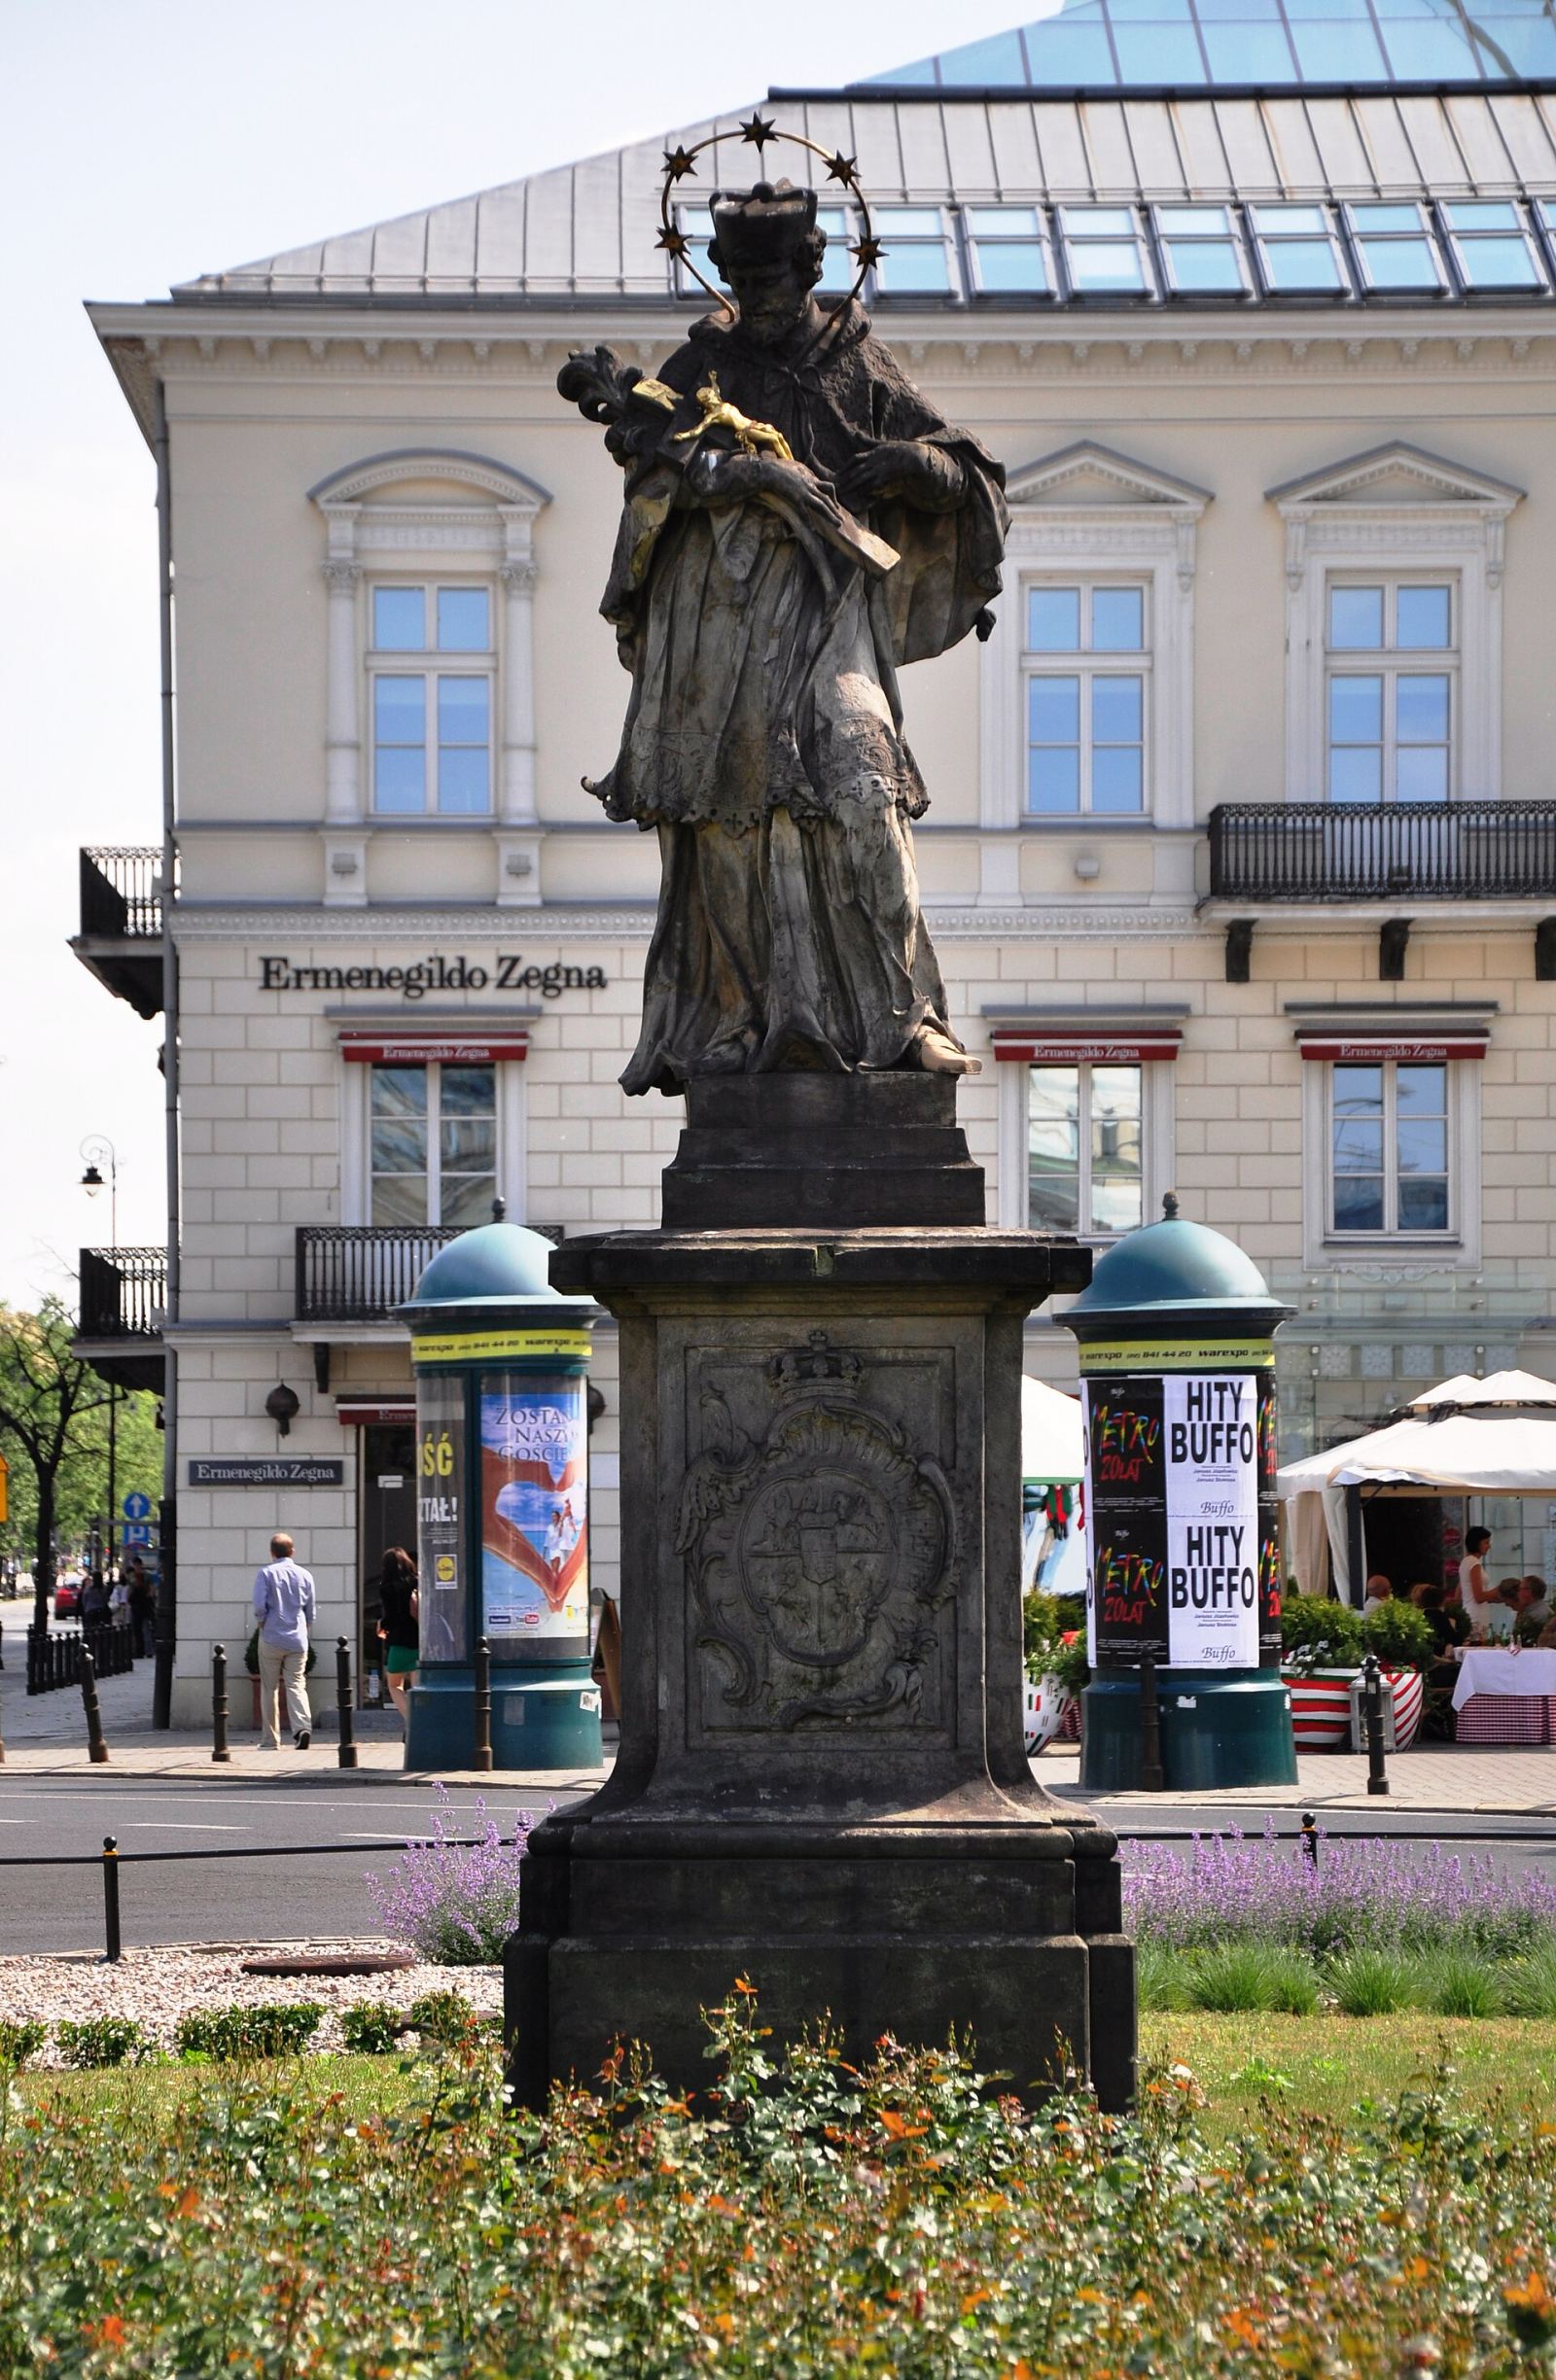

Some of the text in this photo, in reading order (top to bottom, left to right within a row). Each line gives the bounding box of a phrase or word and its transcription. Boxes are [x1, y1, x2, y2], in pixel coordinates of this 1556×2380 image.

[259, 956, 608, 999] Ermenegildo Zegna
[383, 1046, 489, 1059] Ermenegildo Zegna
[1034, 1046, 1139, 1060] Ermenegildo Zegna
[1341, 1045, 1447, 1059] Ermenegildo Zegna
[1198, 1349, 1249, 1358] warexpo
[1186, 1381, 1244, 1421] HITY
[1090, 1402, 1160, 1465] METRO
[1171, 1422, 1254, 1464] BUFFO
[197, 1463, 335, 1482] Ermenegildo Zegna
[1200, 1500, 1235, 1517] Buffo
[1186, 1525, 1245, 1567] HITY
[1095, 1544, 1164, 1607] METRO
[1172, 1567, 1255, 1609] BUFFO
[1202, 1645, 1236, 1662] Buffo
